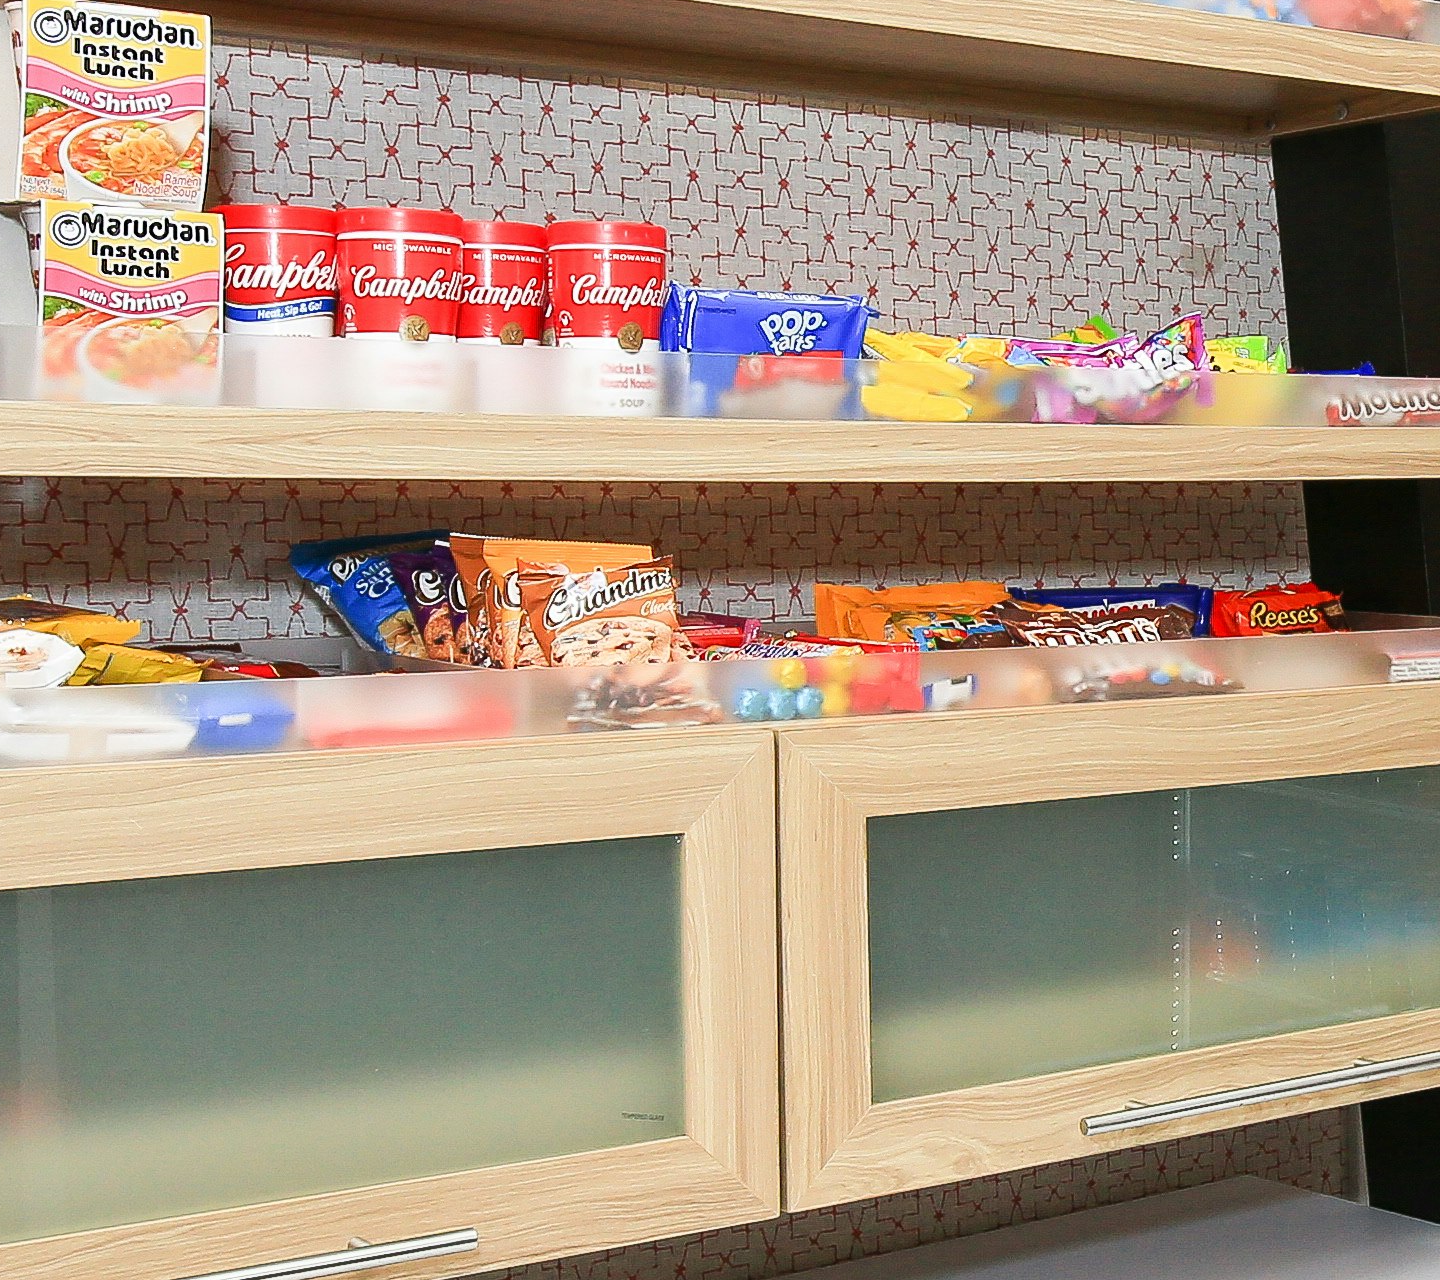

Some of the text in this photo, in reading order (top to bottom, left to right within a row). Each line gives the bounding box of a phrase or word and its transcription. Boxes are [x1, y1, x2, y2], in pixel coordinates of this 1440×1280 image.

[64, 10, 195, 46] Maruchan
[74, 38, 163, 63] Instant
[84, 58, 154, 80] Lunch
[61, 85, 172, 113] with Shrimp
[164, 174, 199, 186] Ramen
[172, 186, 197, 199] Soup
[81, 212, 209, 243] Maruchan
[92, 240, 179, 261] Instant
[101, 259, 169, 278] Lunch
[78, 288, 188, 312] with Shrimp
[257, 308, 283, 319] Heat,
[285, 305, 298, 317] Sip
[299, 303, 307, 313] &
[1251, 603, 1318, 628] Reese's
